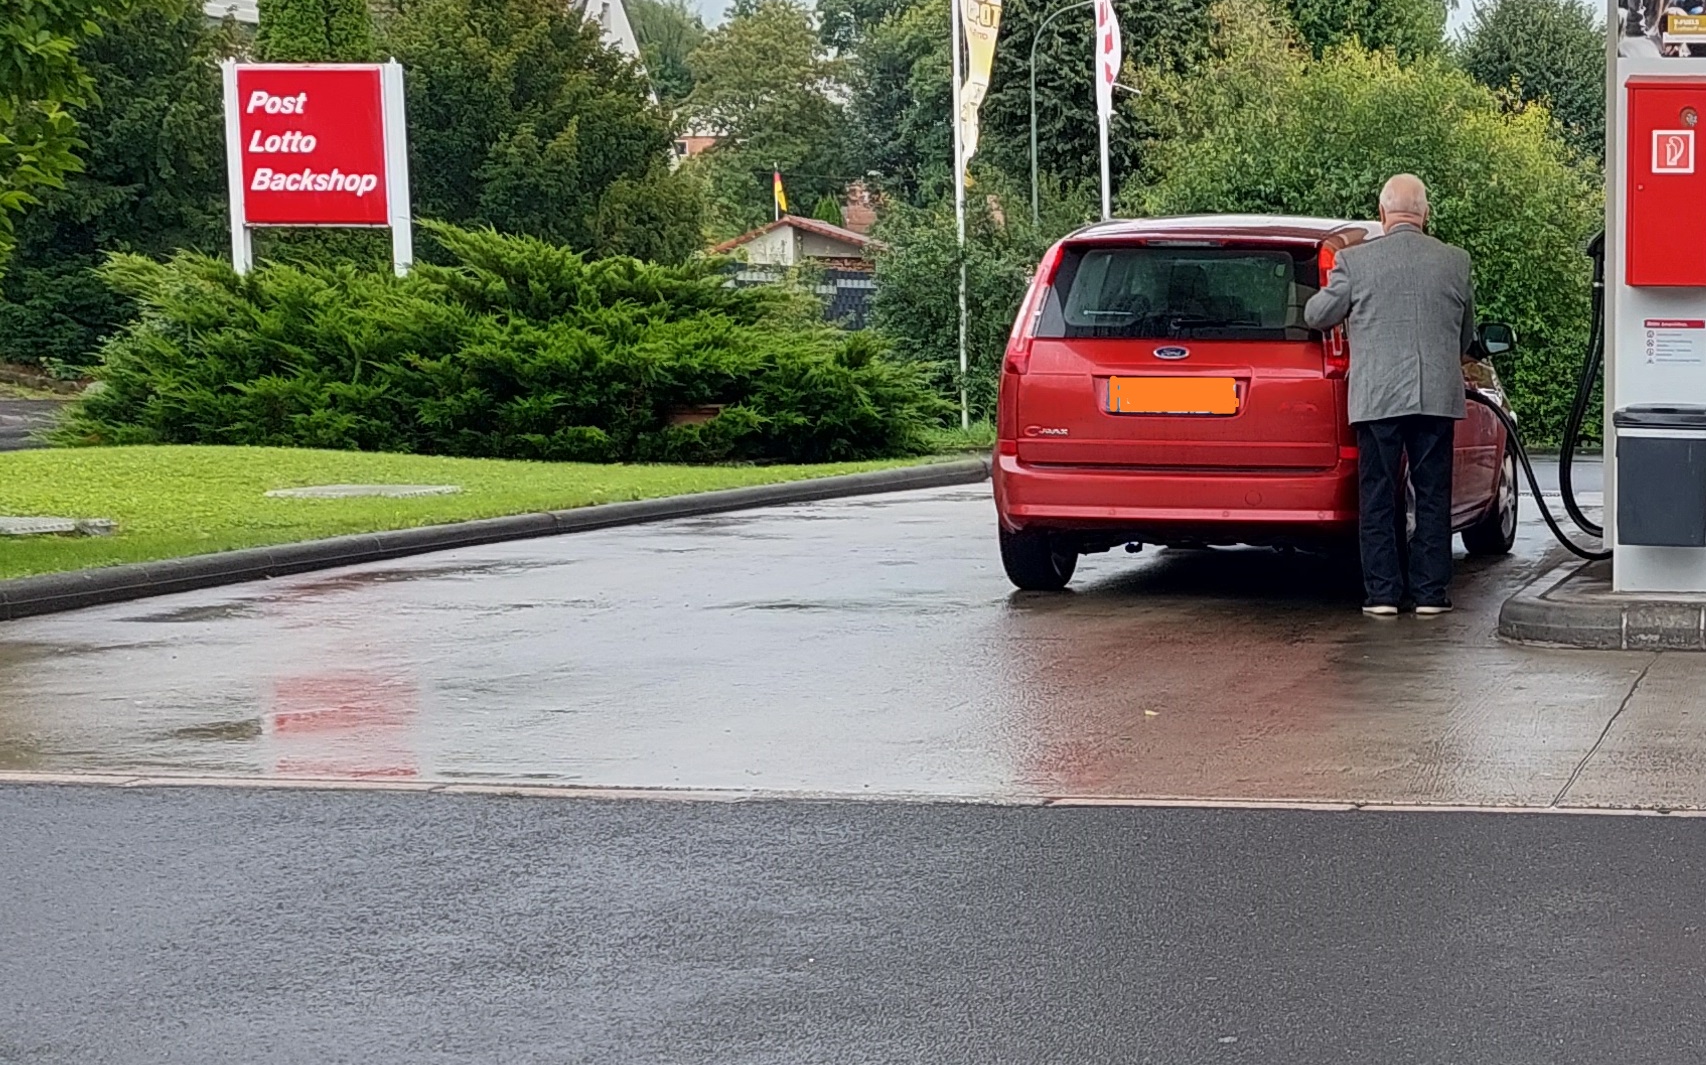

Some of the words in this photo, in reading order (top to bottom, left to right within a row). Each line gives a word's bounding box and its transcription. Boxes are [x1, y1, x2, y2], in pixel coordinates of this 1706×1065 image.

[246, 90, 308, 114] Post
[248, 129, 317, 153] Lotto
[251, 167, 378, 197] Backshop
